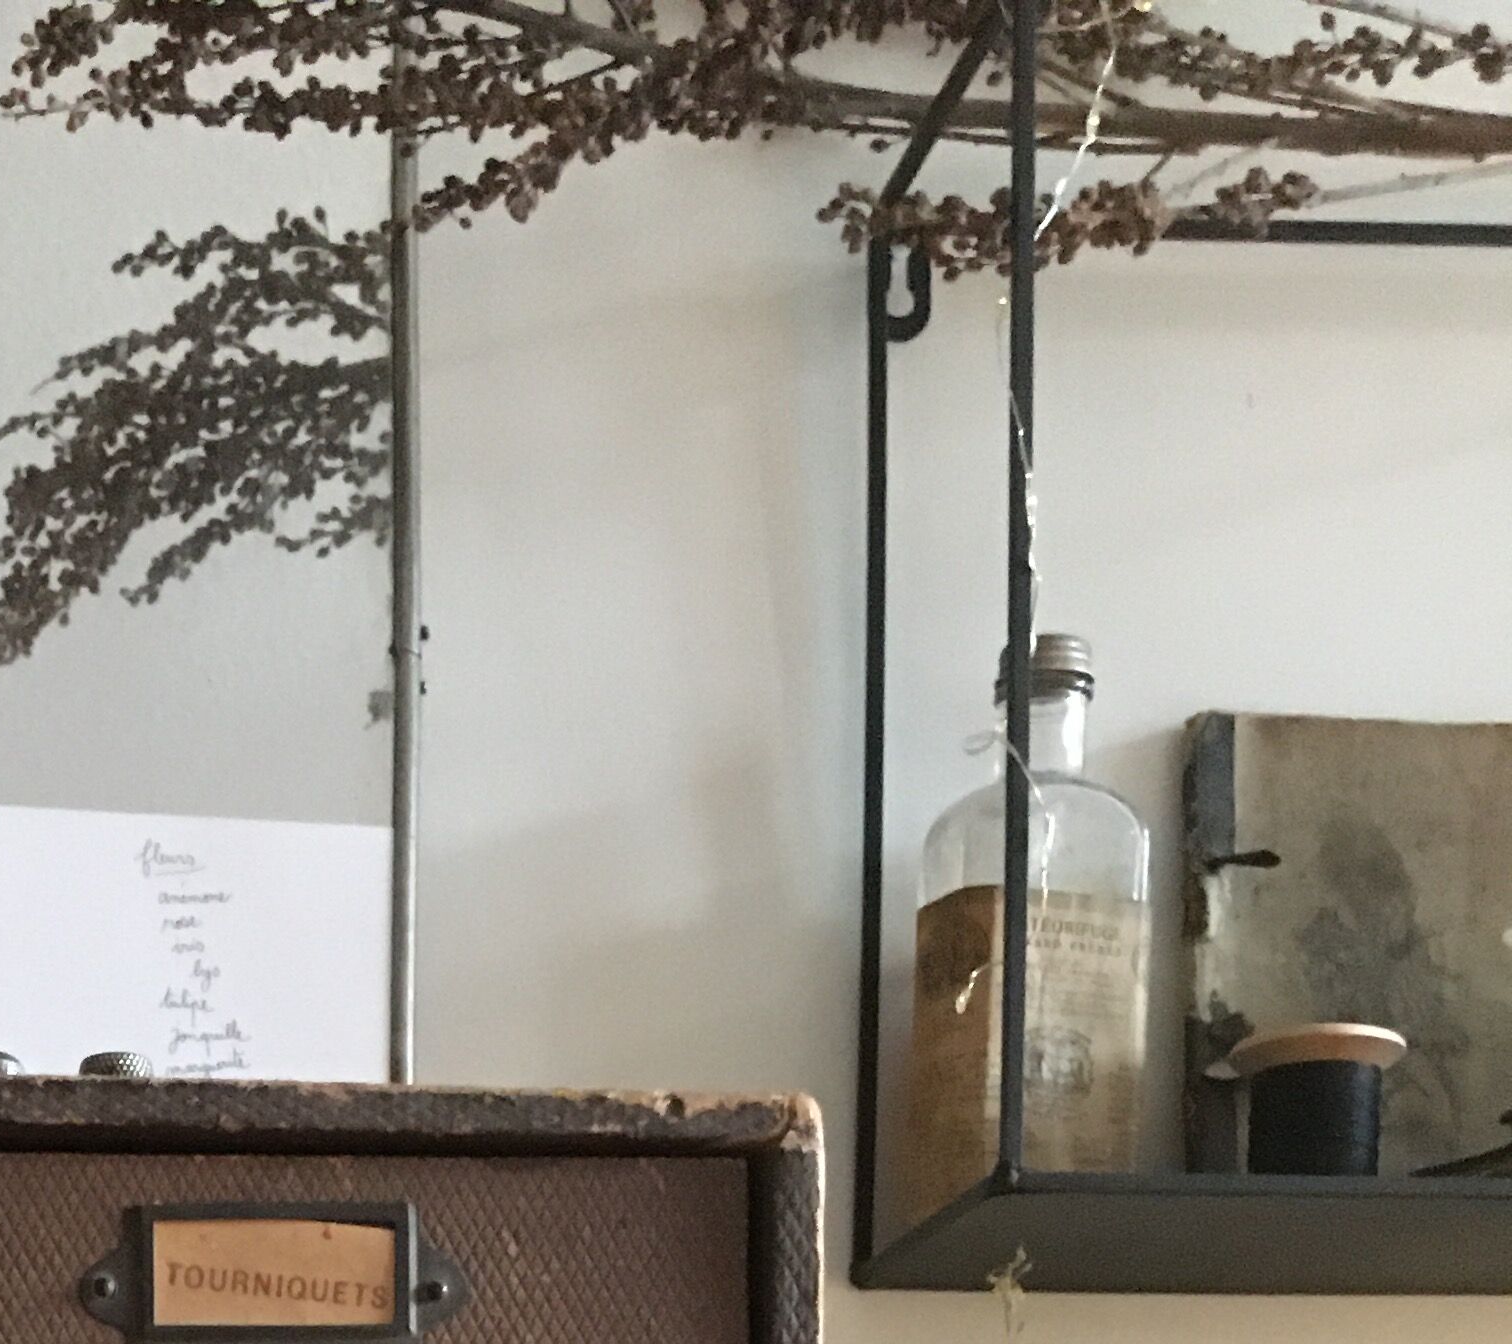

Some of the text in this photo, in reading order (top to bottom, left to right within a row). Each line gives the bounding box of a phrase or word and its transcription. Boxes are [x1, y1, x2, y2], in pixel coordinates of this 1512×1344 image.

[133, 837, 196, 878] fleurs
[158, 986, 215, 1028] tulipe
[166, 1260, 388, 1309] TOURNIQUETS
